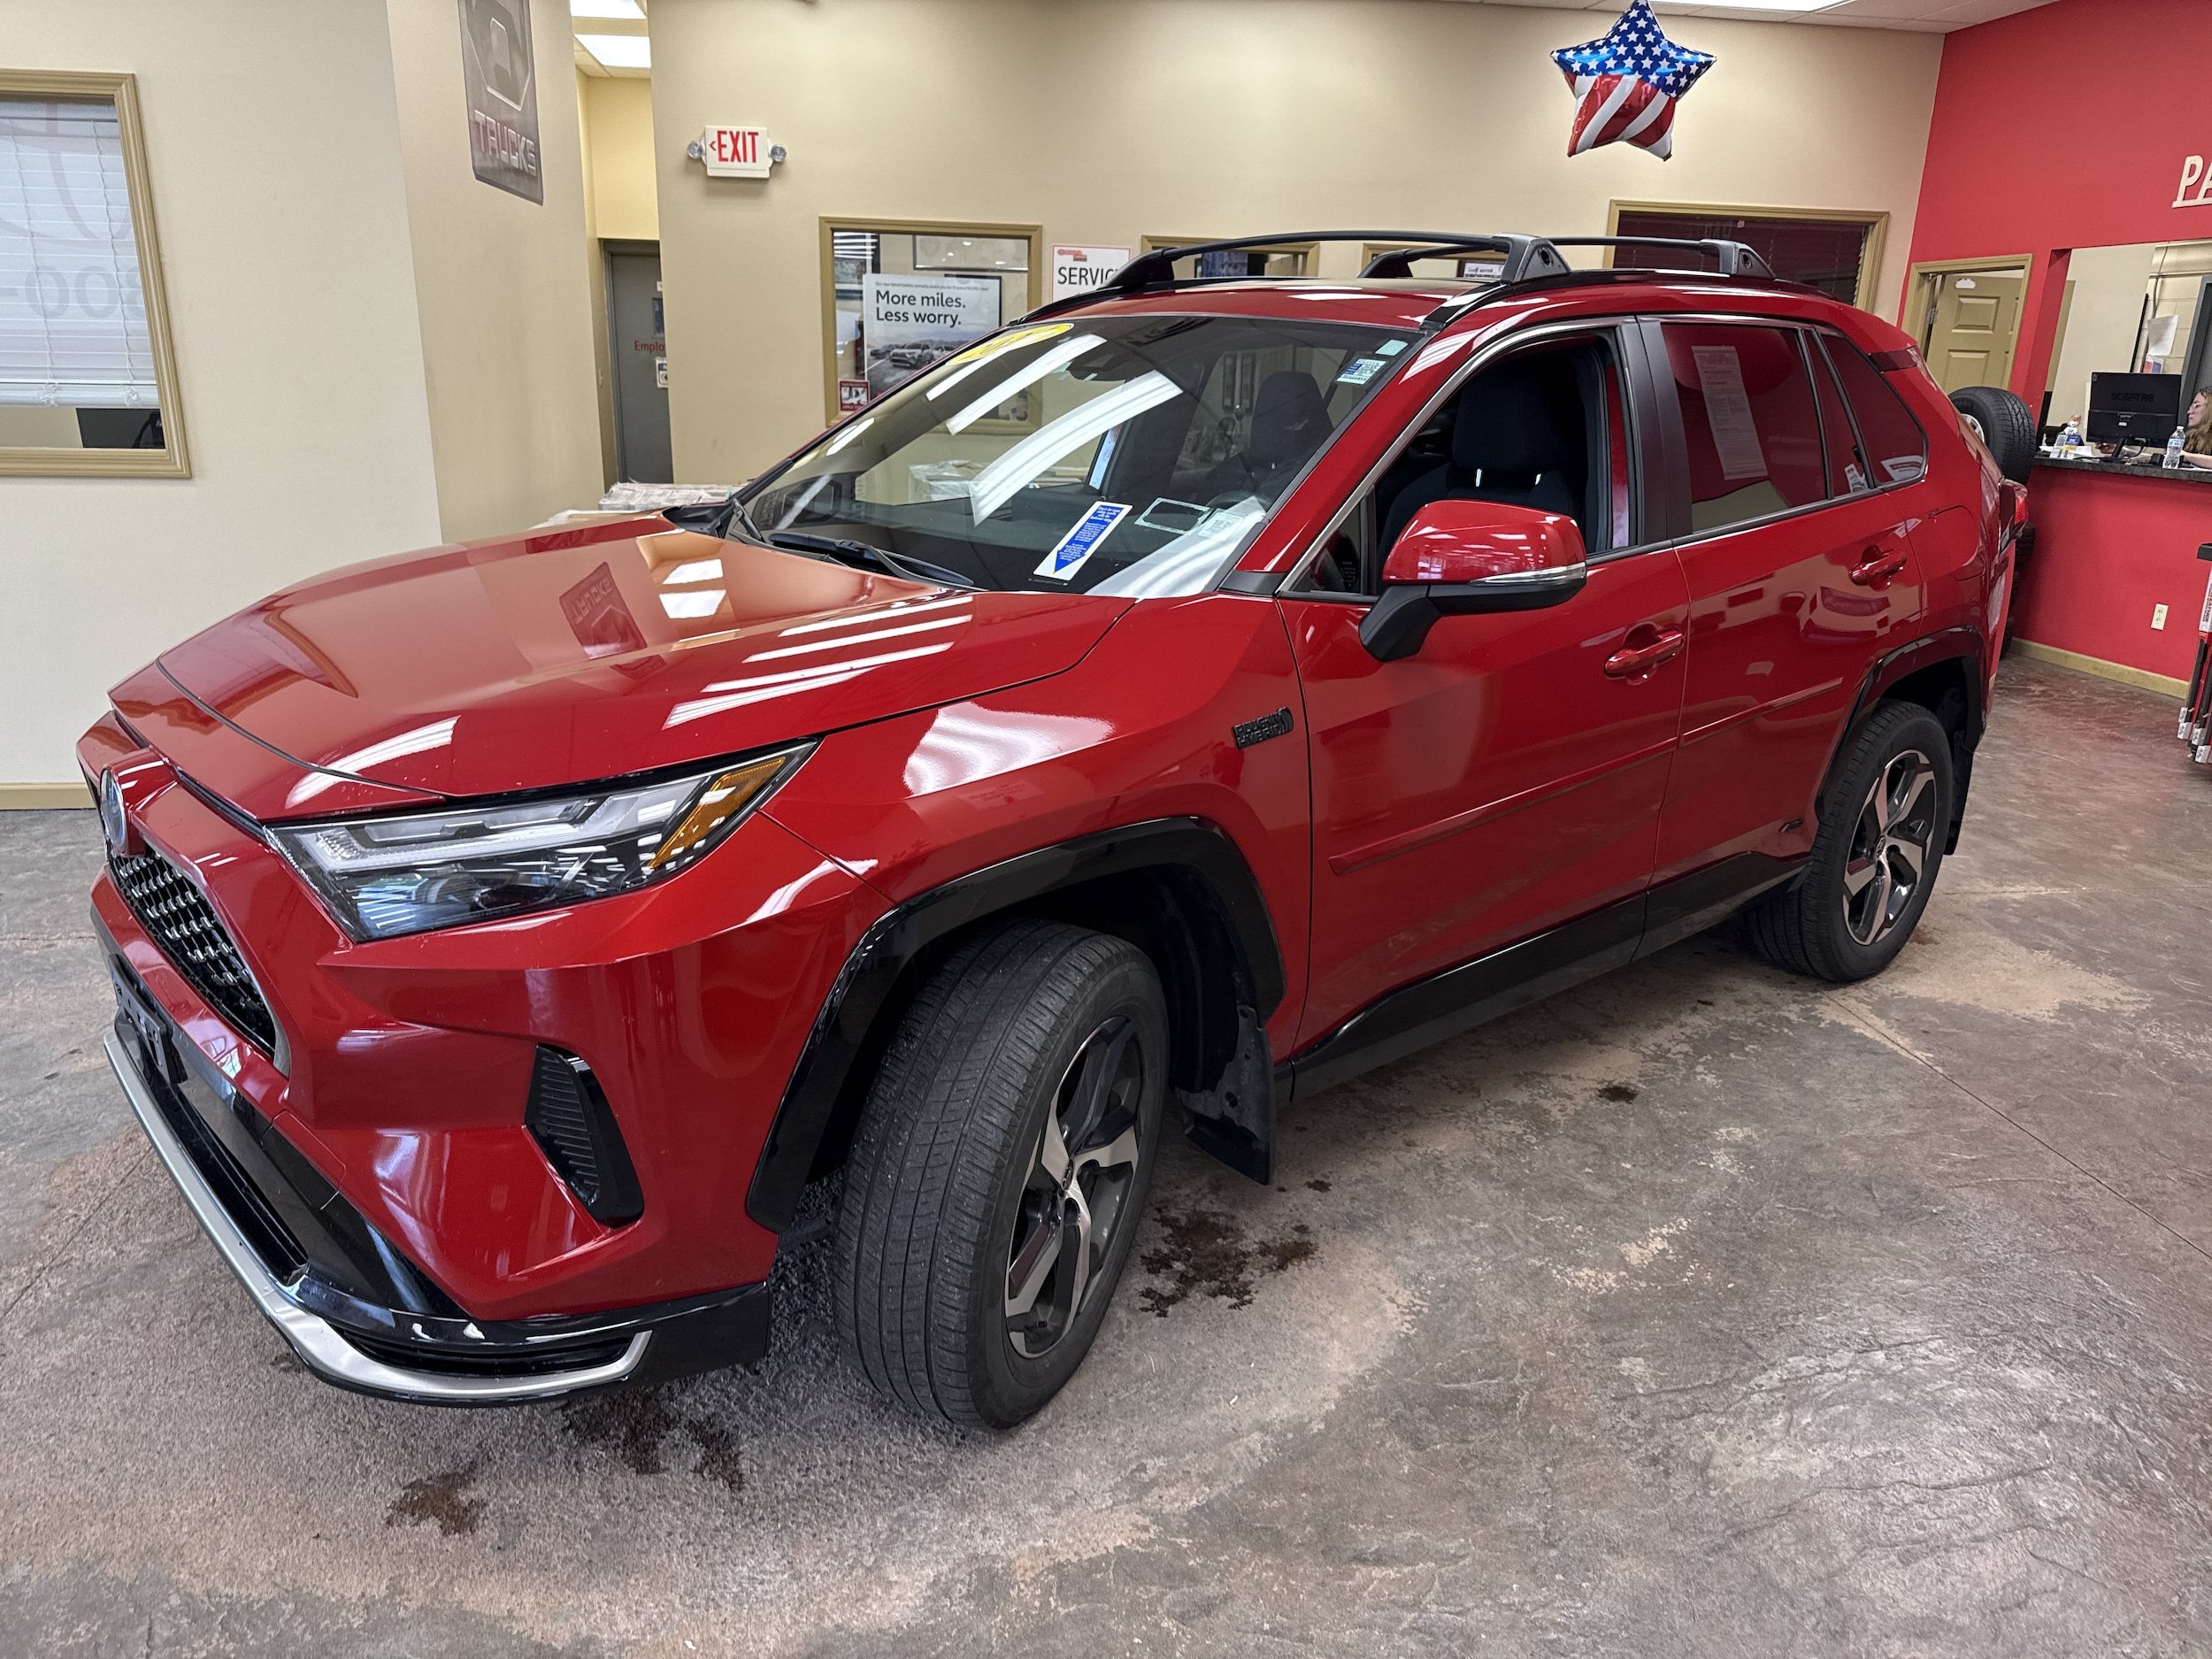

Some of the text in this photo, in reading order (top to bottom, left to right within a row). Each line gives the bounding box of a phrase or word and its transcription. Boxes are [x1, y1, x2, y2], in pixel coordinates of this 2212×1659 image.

[474, 110, 537, 177] TRUCKS
[717, 130, 759, 163] EXIT
[1057, 266, 1118, 286] SERVIC
[876, 289, 966, 308] More miles.
[876, 306, 962, 327] Less worry.
[634, 340, 666, 354] Emplo
